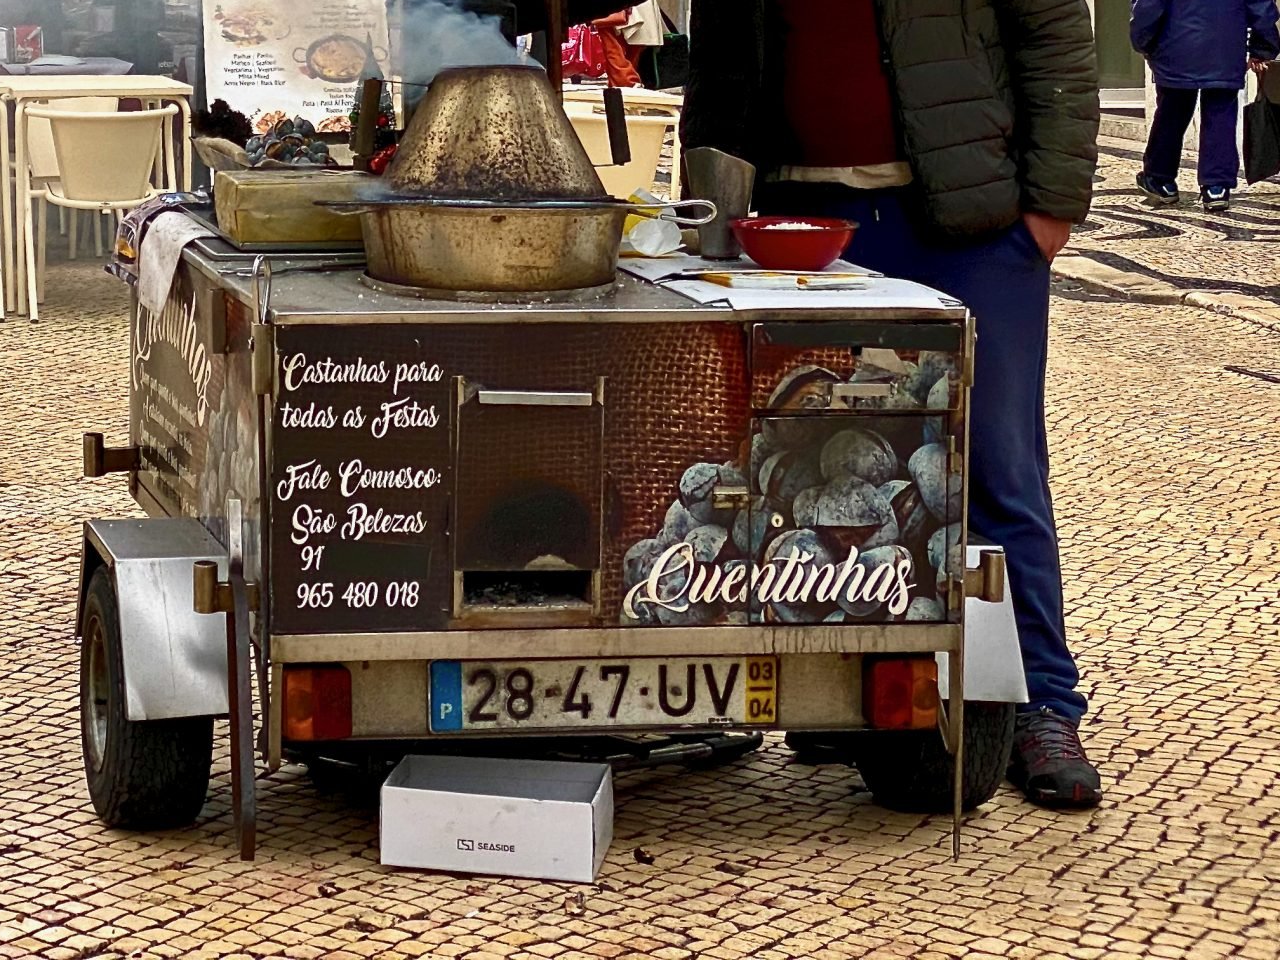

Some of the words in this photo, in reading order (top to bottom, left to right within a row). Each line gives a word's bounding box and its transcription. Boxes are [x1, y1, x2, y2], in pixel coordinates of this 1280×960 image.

[283, 352, 390, 391] Castanhas
[393, 360, 444, 395] para
[280, 401, 338, 429] todas
[342, 405, 367, 429] as
[371, 396, 440, 439] Festas
[277, 458, 332, 501] Fale
[338, 459, 442, 498] Connosco:
[291, 504, 337, 545] São
[340, 502, 428, 541] Belezas
[301, 545, 326, 571] 91
[296, 582, 334, 608] 965
[341, 581, 379, 608] 480
[385, 580, 420, 608] 018
[623, 542, 917, 619] Quentinhas
[749, 661, 774, 681] 03
[440, 703, 453, 720] P
[749, 698, 774, 719] 04
[477, 842, 516, 853] SEASIDE
